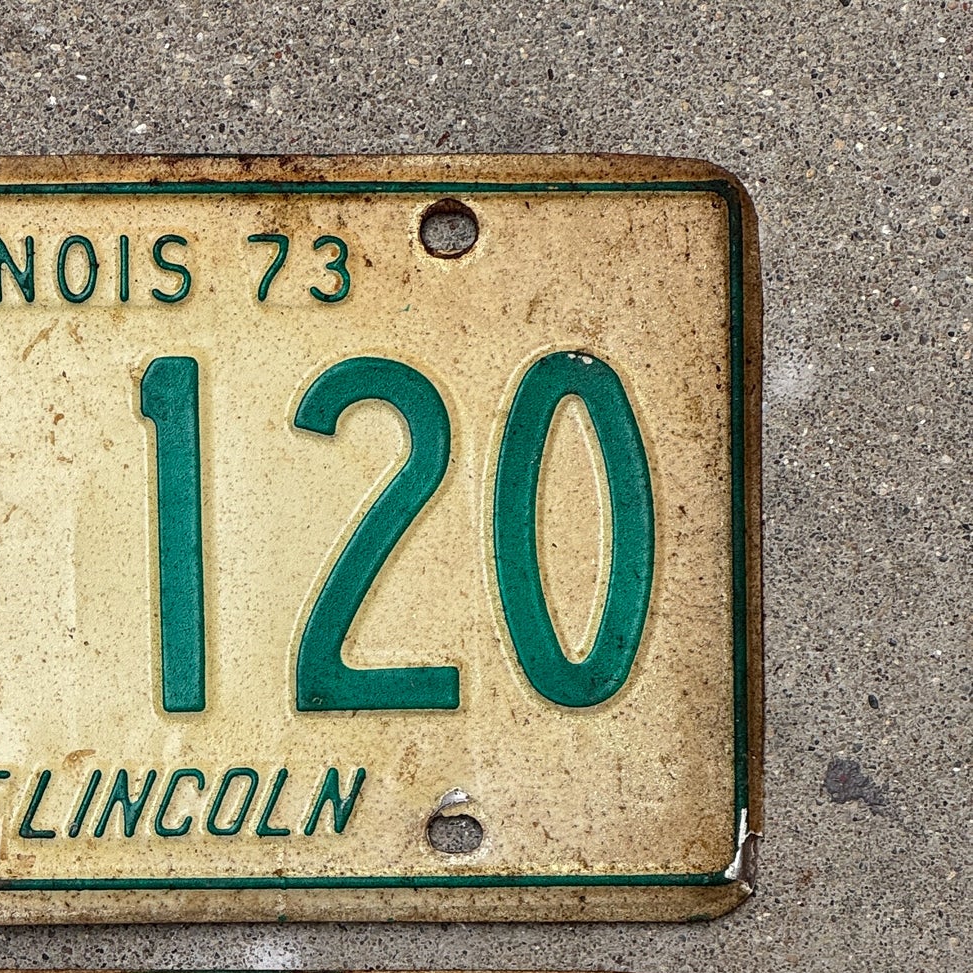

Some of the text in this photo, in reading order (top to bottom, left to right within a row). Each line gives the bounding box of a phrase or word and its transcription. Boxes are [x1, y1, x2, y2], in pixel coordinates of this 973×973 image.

[248, 235, 351, 303] 73
[140, 352, 655, 712] 120
[19, 768, 366, 839] LINCOLN
